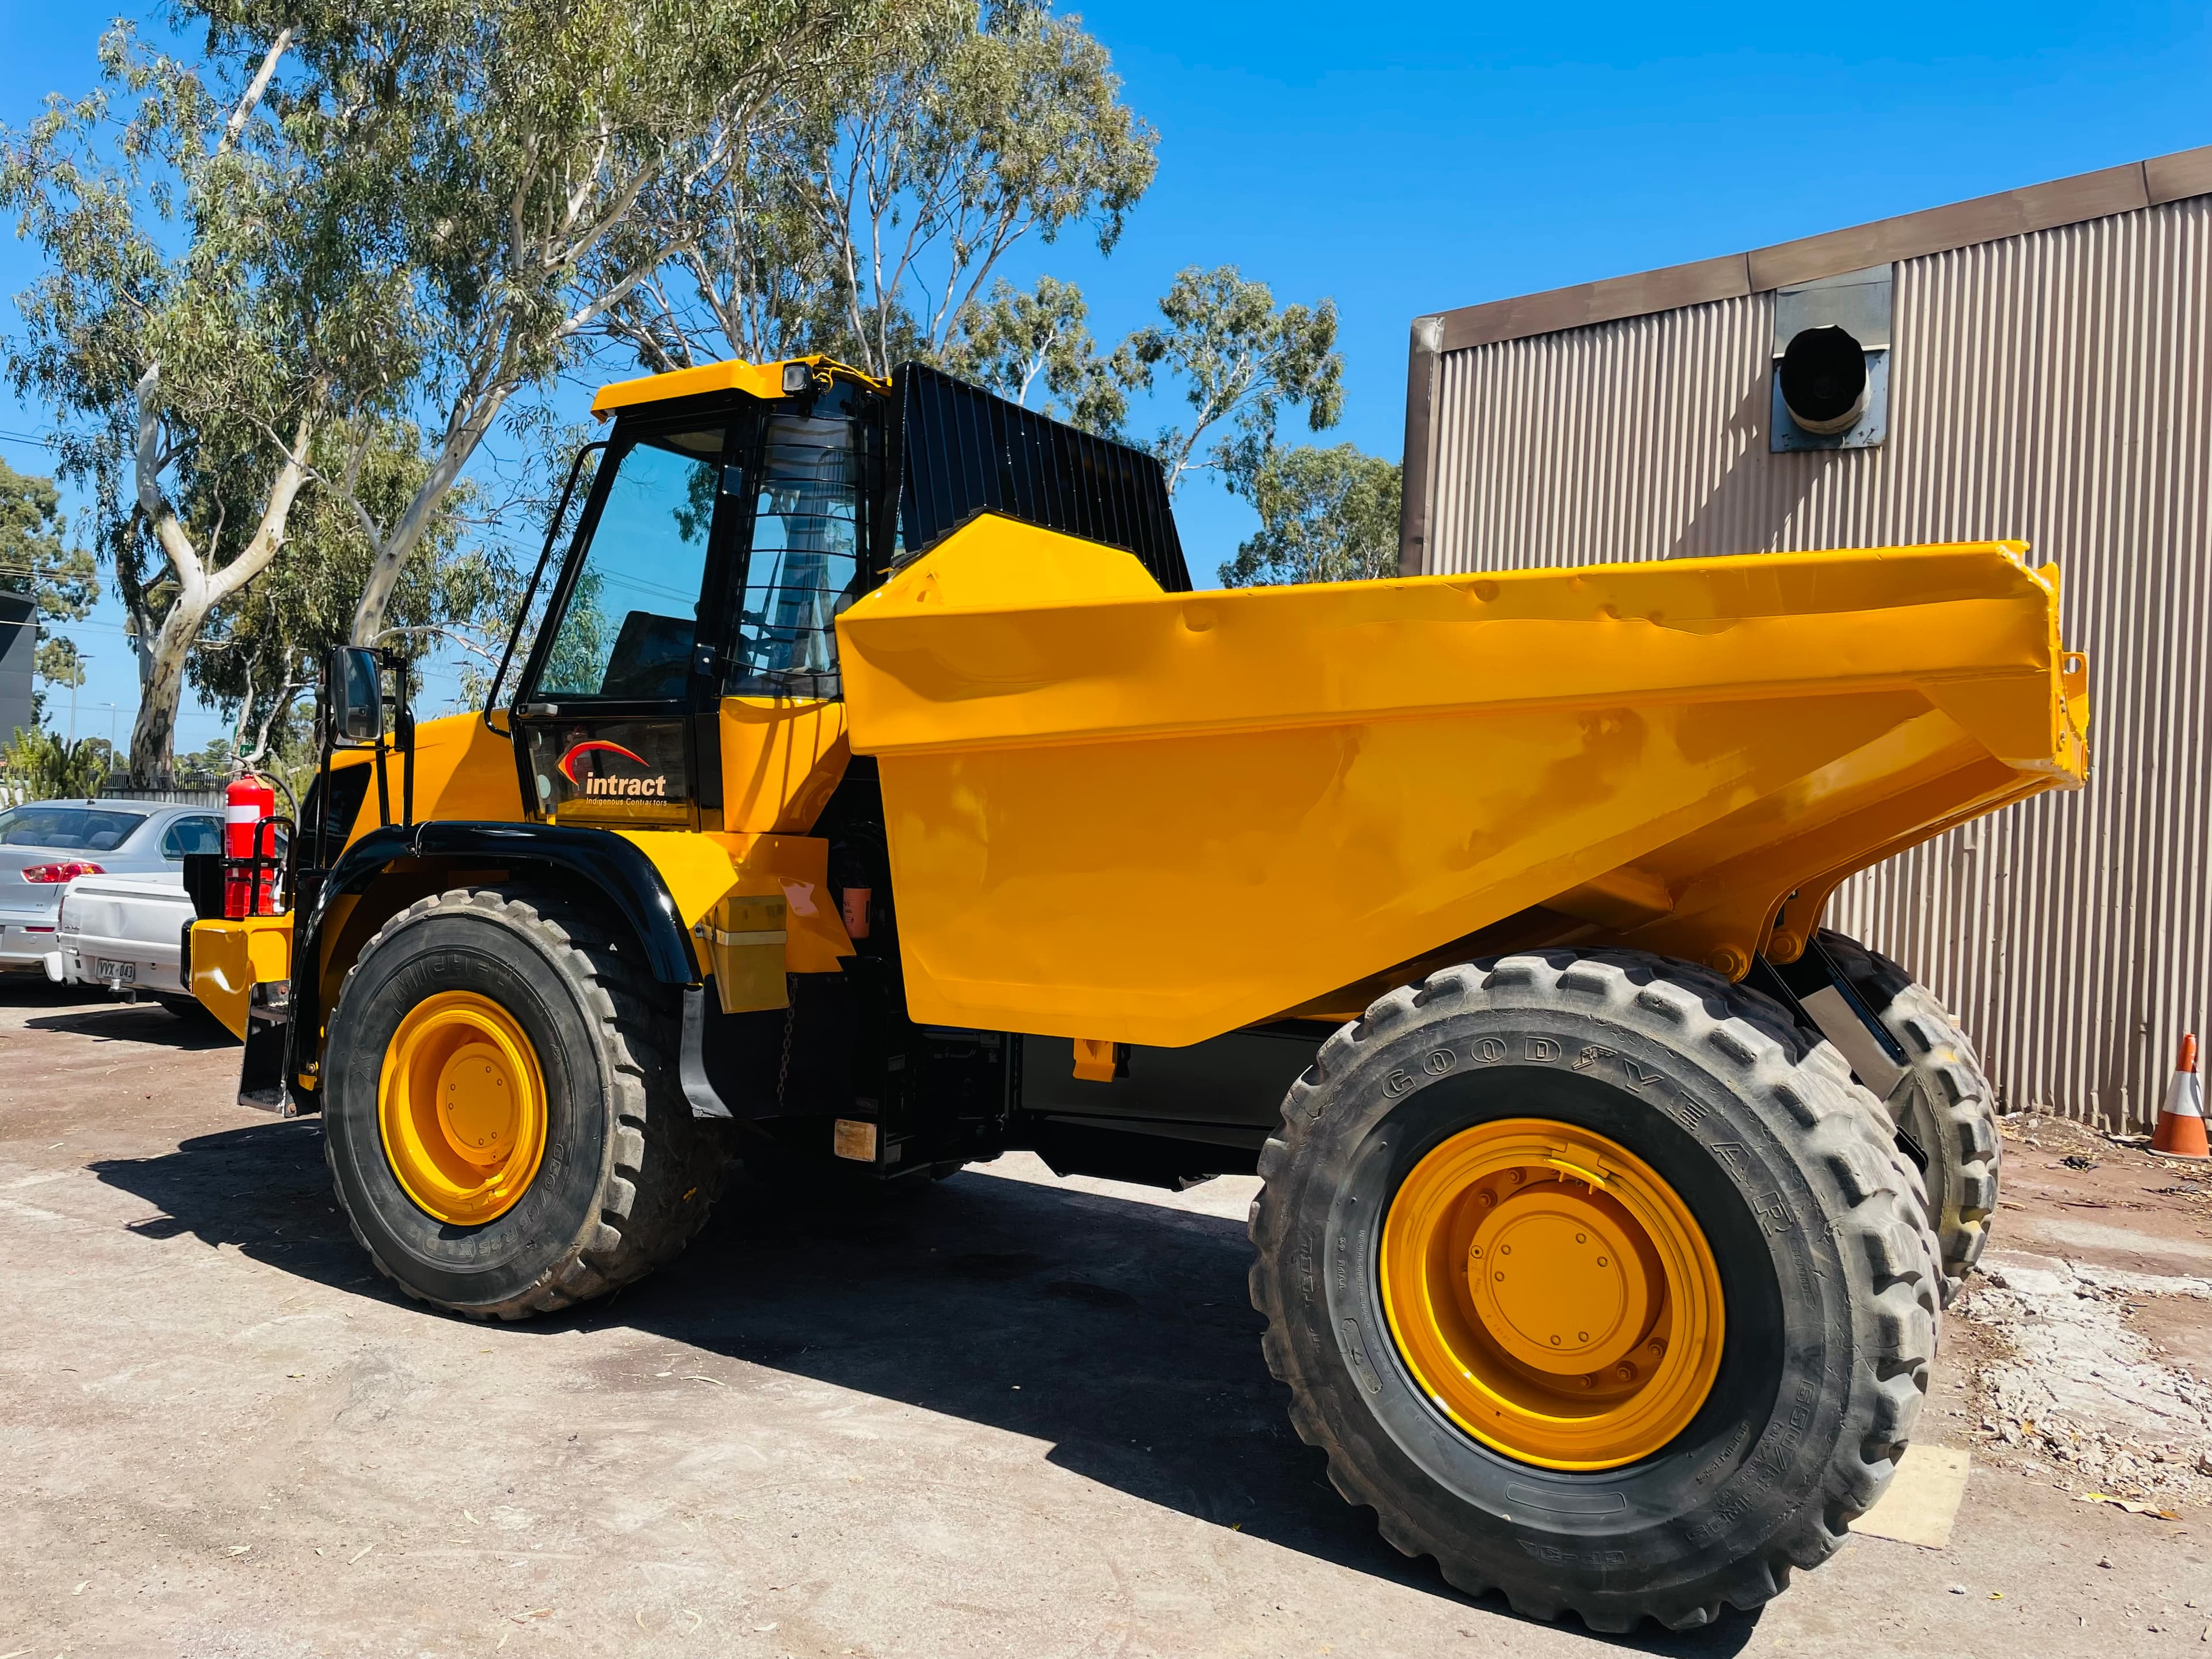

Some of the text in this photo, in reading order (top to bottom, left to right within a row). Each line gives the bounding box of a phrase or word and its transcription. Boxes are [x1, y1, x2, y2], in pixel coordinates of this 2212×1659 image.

[586, 772, 666, 796] intract
[586, 797, 668, 806] Indigenous Contractors
[1382, 1036, 1793, 1237] GOODYEAR
